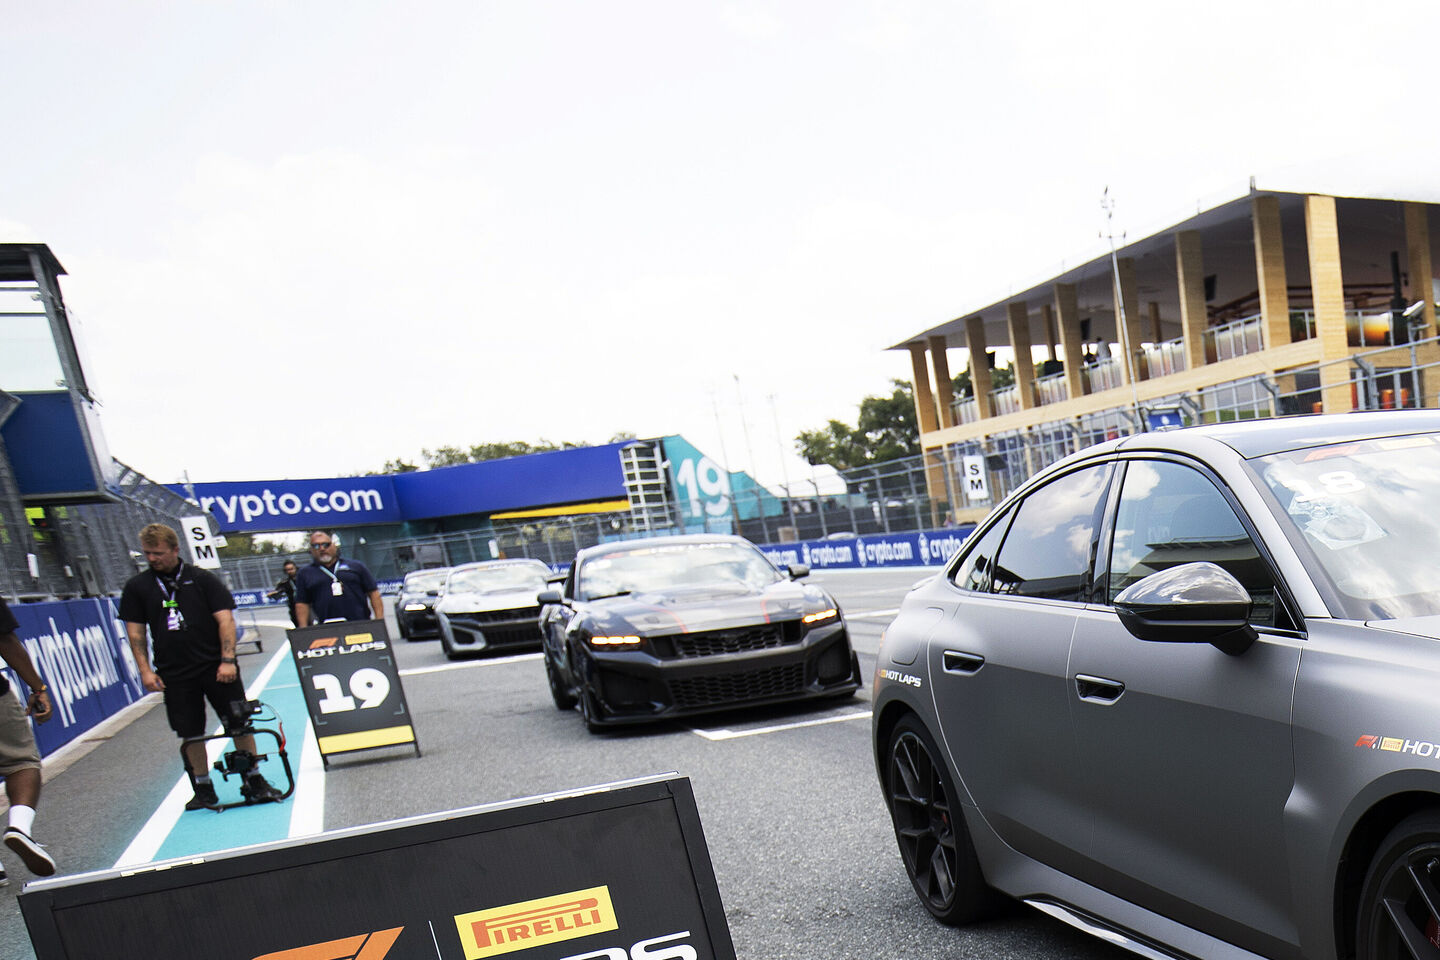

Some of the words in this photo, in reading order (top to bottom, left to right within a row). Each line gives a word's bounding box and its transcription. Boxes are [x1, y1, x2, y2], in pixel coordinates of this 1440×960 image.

[677, 456, 730, 517] 19
[865, 540, 914, 565] crypto.com
[930, 534, 967, 562] crypto
[297, 646, 336, 659] HOT
[338, 641, 387, 654] LAPS
[21, 616, 119, 728] rypto.com
[885, 669, 900, 681] HOT
[899, 672, 922, 688] LAPS
[312, 668, 390, 714] 19
[471, 897, 601, 949] PIRELLI
